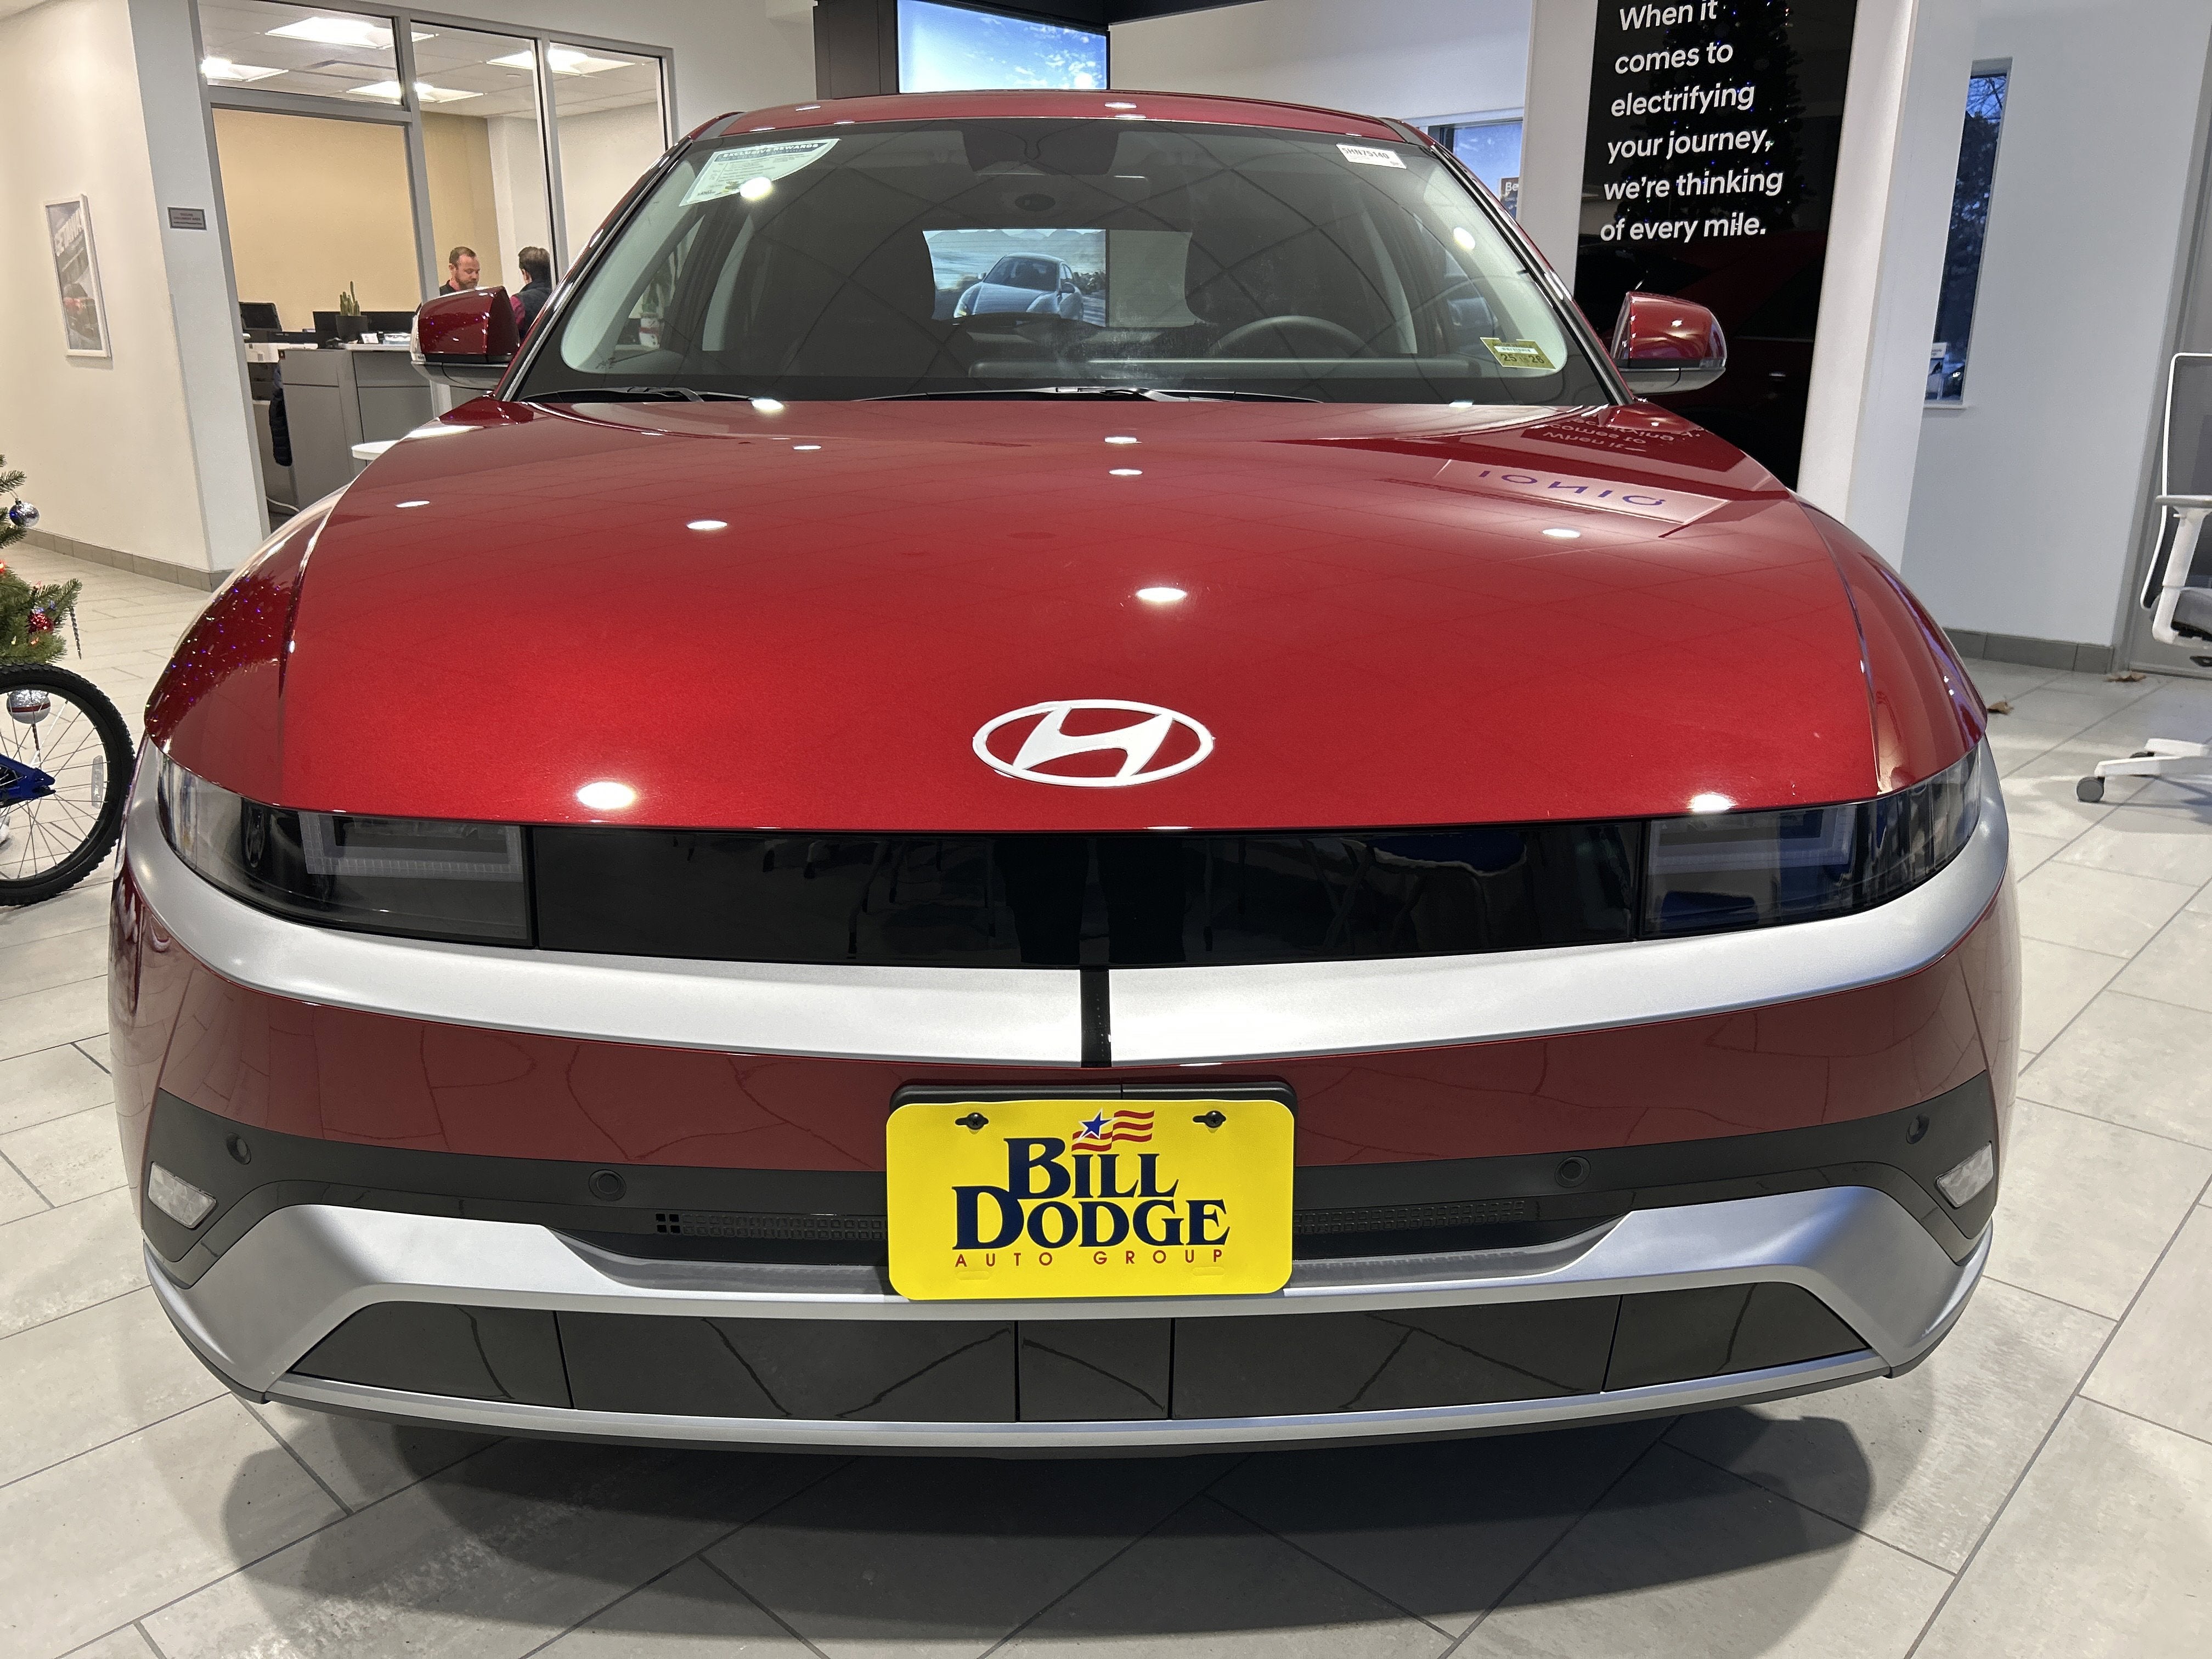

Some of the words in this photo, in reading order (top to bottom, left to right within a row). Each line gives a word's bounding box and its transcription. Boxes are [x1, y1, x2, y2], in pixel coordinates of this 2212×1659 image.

[1620, 4, 1693, 31] When
[1700, 0, 1718, 21] it
[1615, 48, 1700, 74] comes
[1706, 42, 1733, 64] to
[1611, 82, 1755, 117] electrifying
[1607, 138, 1663, 164] your
[1666, 129, 1774, 160] journey,
[1604, 176, 1670, 200] we're
[1676, 167, 1784, 196] thinking
[1600, 217, 1626, 241] of
[1629, 220, 1699, 243] every
[1703, 212, 1766, 237] mile.
[1500, 353, 1517, 362] 25
[1528, 355, 1545, 364] 26
[1003, 1137, 1179, 1200] BILL
[951, 1186, 1231, 1250] DODGE
[955, 1251, 1053, 1267] AUTO
[1092, 1249, 1223, 1265] GROUP
